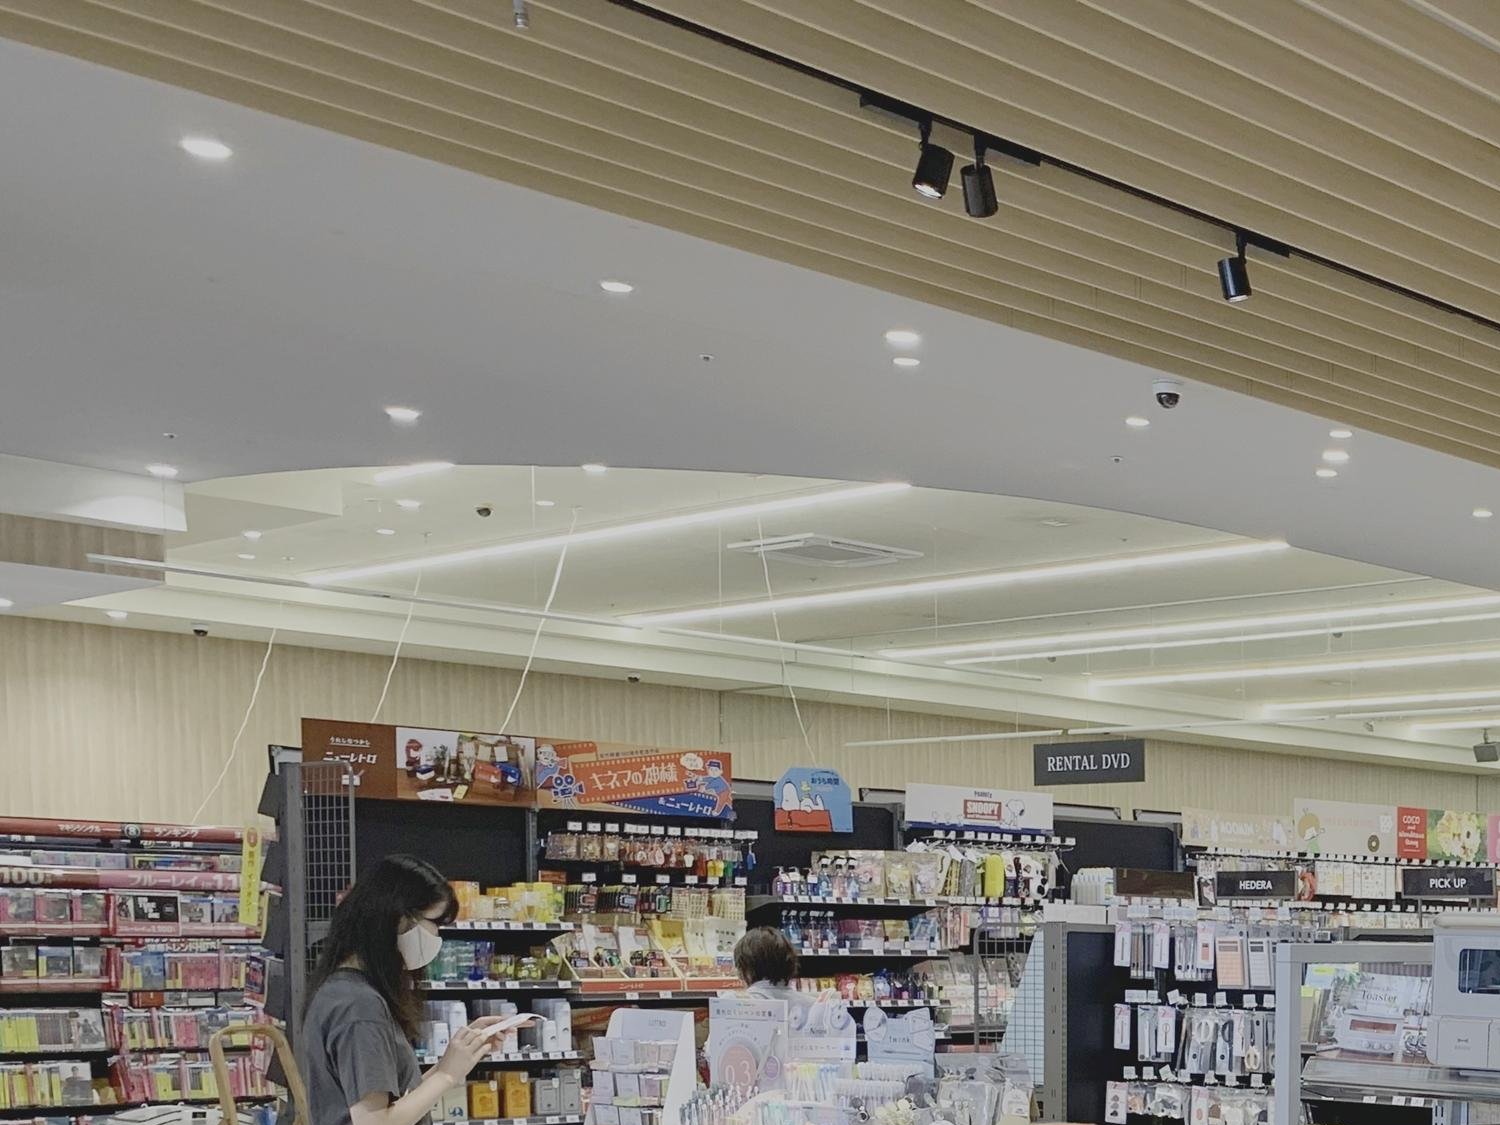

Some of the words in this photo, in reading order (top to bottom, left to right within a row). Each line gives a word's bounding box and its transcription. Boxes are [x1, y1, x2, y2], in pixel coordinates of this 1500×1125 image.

[323, 752, 377, 764] ニューレトロ
[1047, 754, 1098, 772] RENTAL
[1102, 752, 1131, 770] DVD
[589, 762, 679, 791] キネマの神様
[966, 801, 1000, 816] SNOOPY
[1402, 815, 1421, 825] COCO
[128, 873, 198, 888] ブルーレイ
[1239, 880, 1273, 890] HEDERA
[1429, 878, 1451, 889] PICK
[1453, 878, 1467, 889] UP
[1361, 989, 1398, 1002] Toaster
